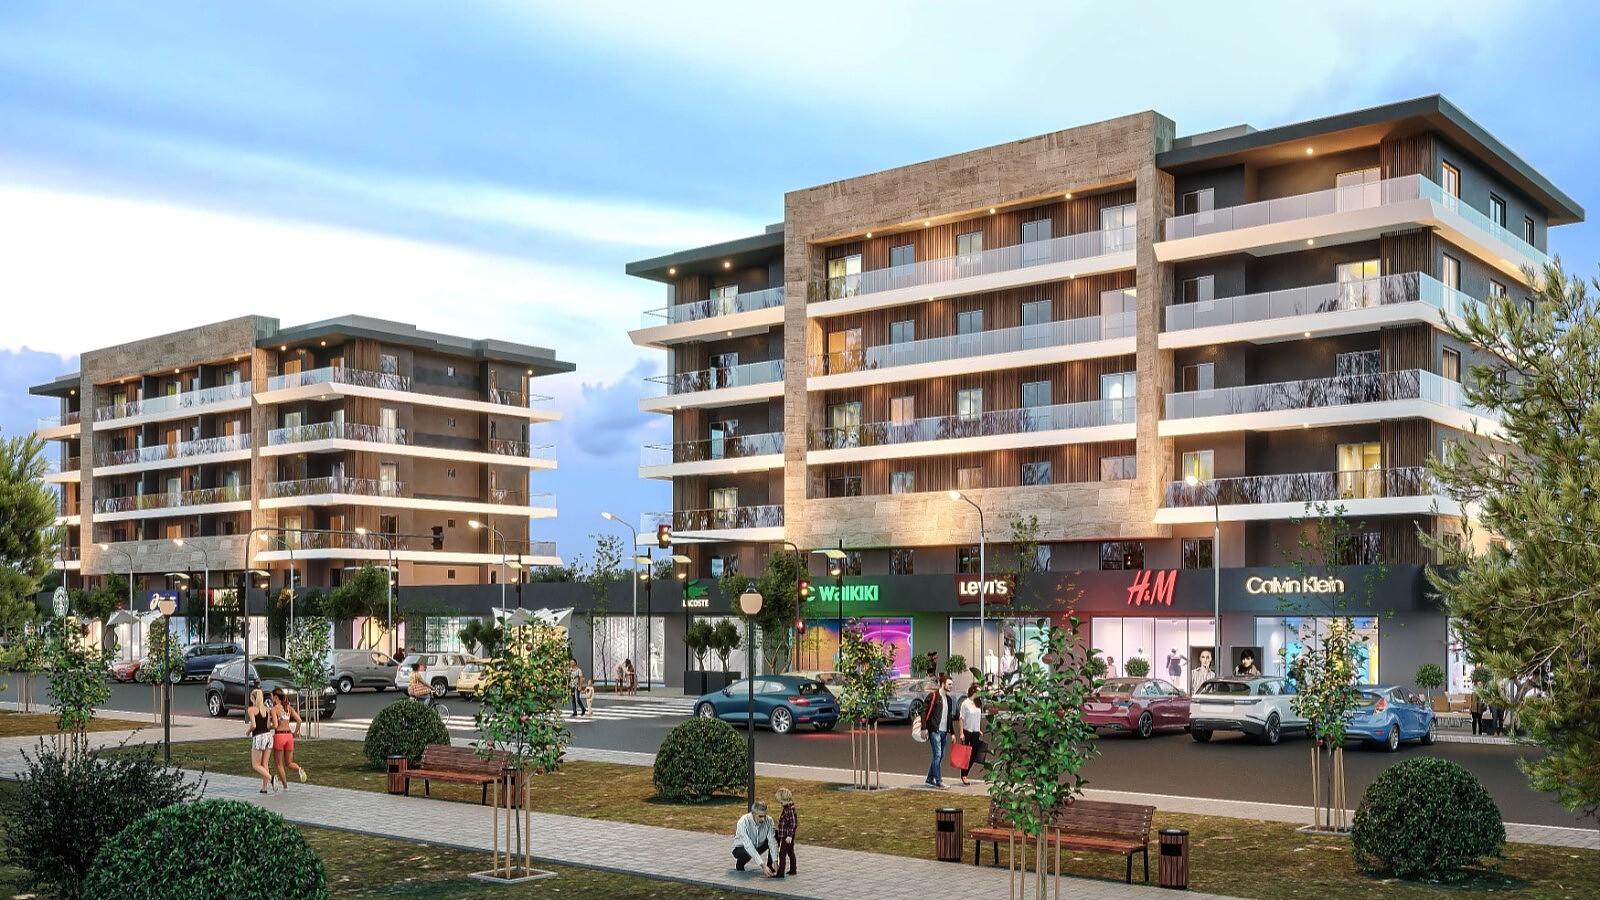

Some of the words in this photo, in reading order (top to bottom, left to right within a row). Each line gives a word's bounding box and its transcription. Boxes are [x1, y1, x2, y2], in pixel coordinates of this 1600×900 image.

[1127, 570, 1177, 606] H&M
[1246, 576, 1301, 594] Calvin
[1303, 576, 1345, 593] Klein
